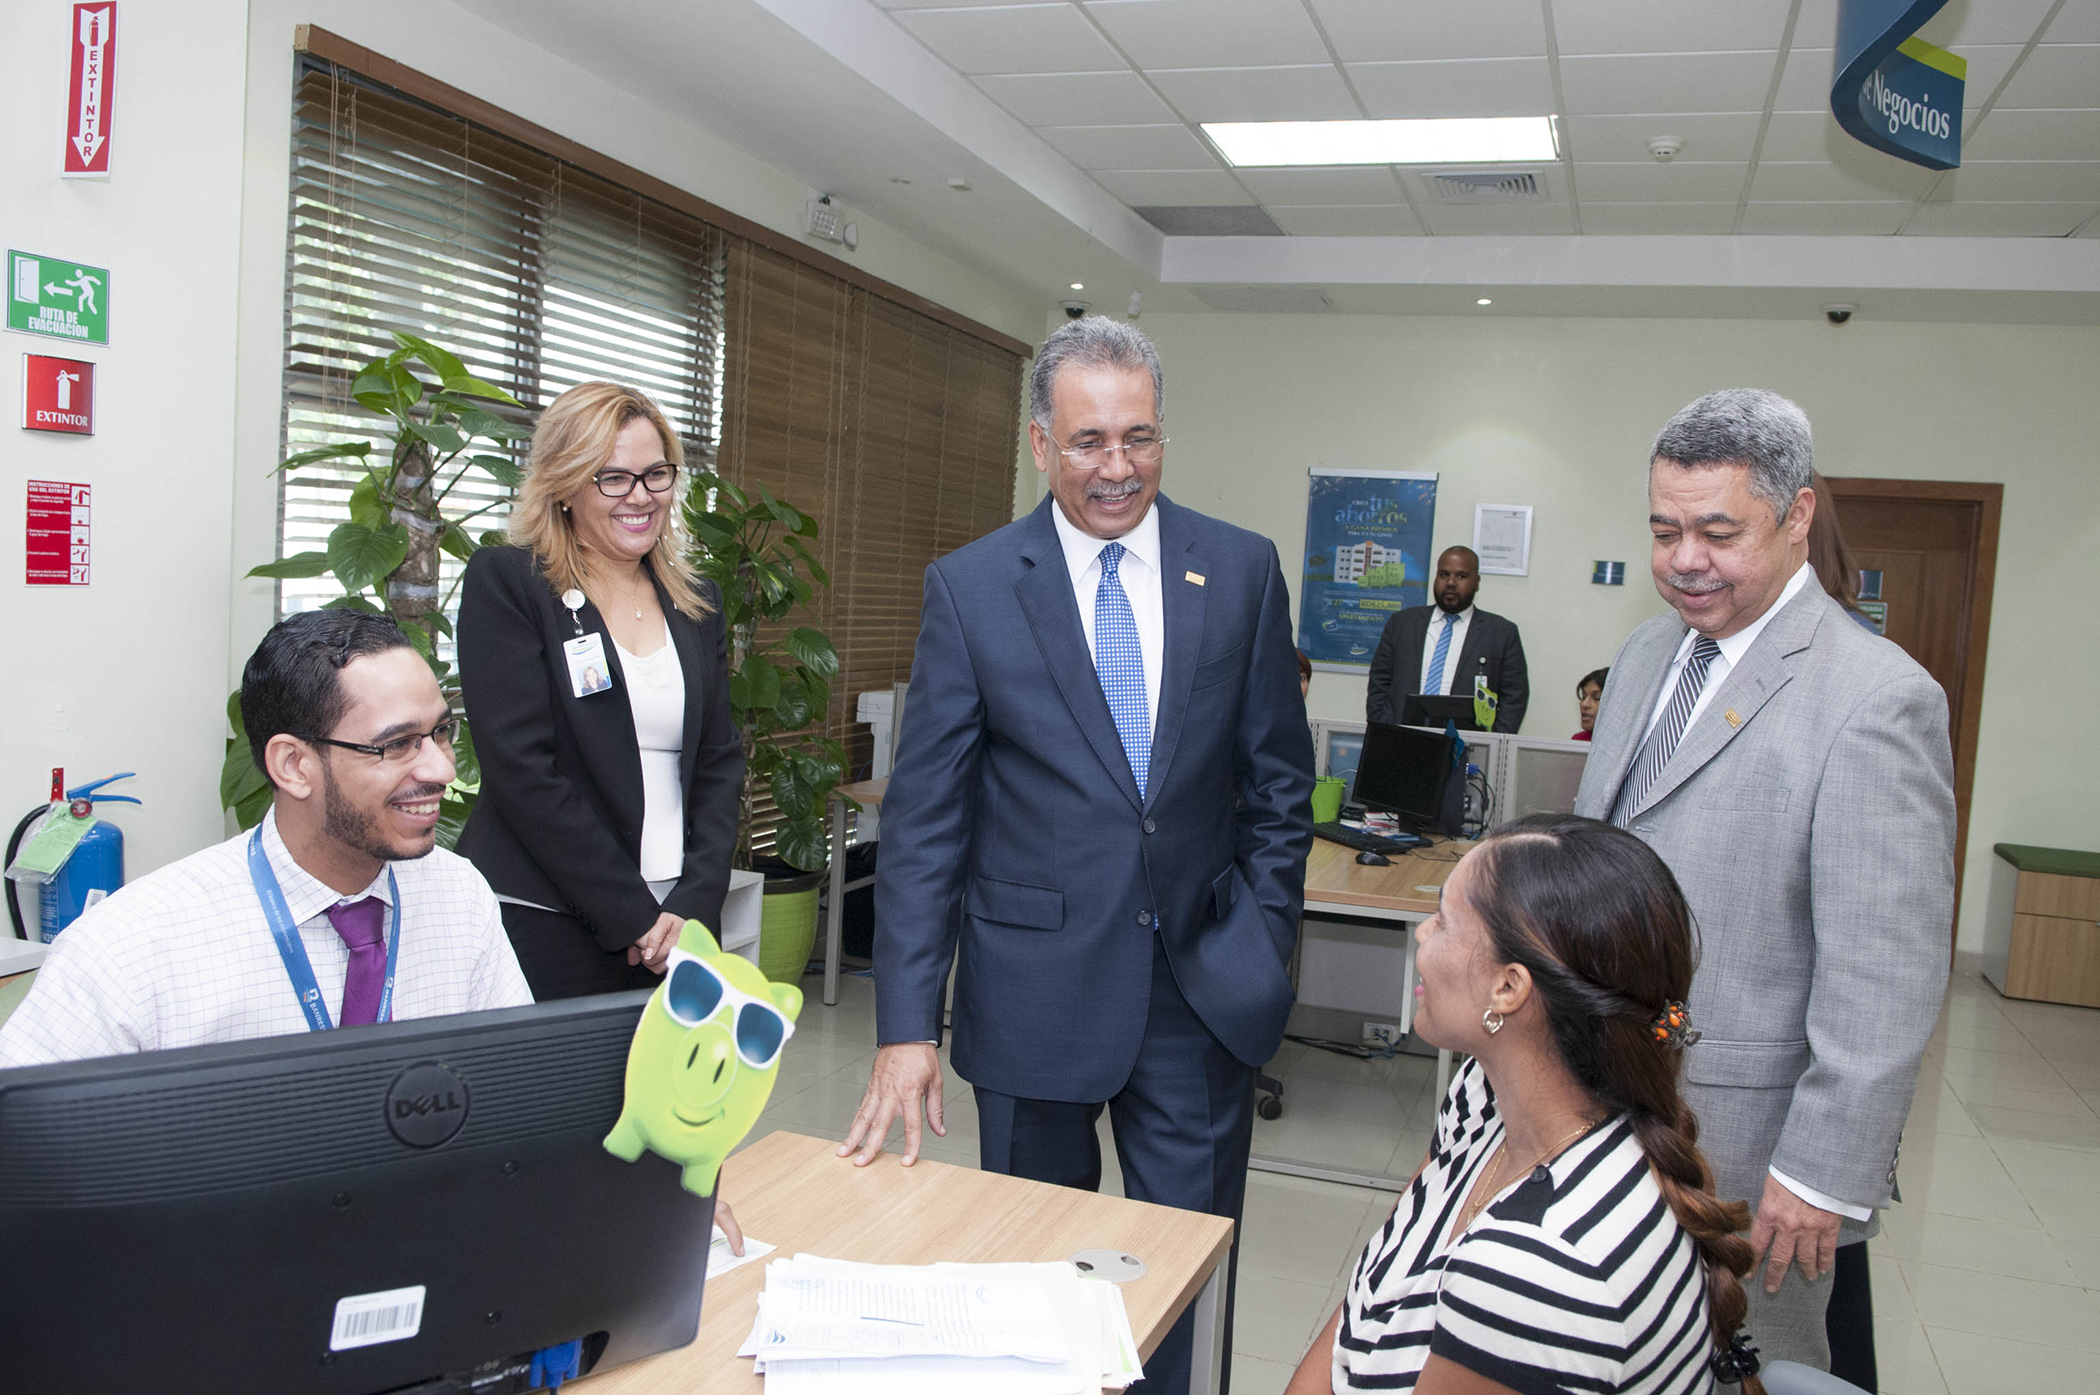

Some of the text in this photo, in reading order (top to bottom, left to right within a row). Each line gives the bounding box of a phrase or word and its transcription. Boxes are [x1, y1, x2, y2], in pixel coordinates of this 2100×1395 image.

[83, 50, 98, 157] EXTINTOR
[1873, 69, 1950, 139] Negocios
[28, 316, 88, 338] EVACUACION
[40, 306, 78, 324] RUTA DE
[36, 410, 88, 427] EXTINTOR
[1335, 504, 1408, 525] ahorros
[310, 1002, 326, 1031] BANRES
[395, 1092, 461, 1119] DELL
